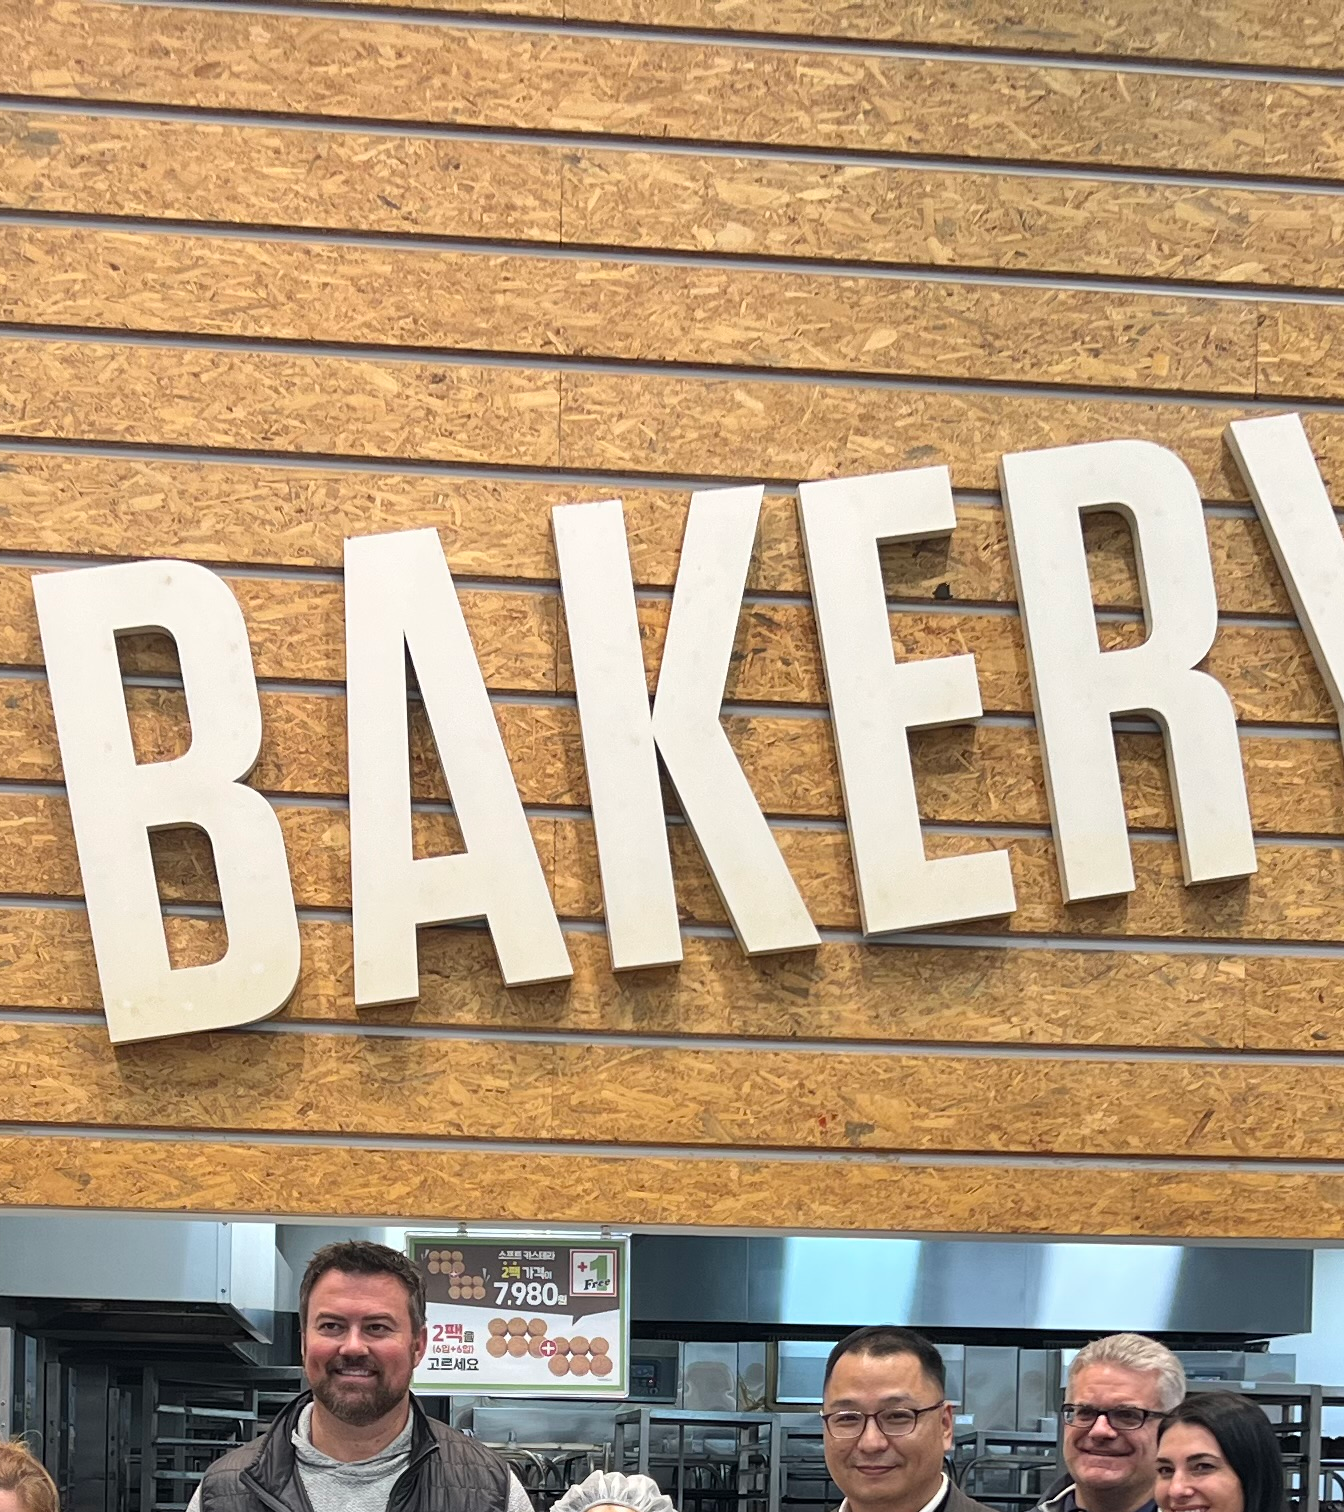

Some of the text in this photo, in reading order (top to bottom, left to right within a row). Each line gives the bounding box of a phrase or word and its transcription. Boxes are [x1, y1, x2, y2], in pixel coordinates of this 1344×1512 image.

[498, 1250, 555, 1261] 소프트 카스테라
[501, 1266, 552, 1279] 2팩 가격이
[583, 1279, 611, 1291] Free
[427, 1358, 479, 1371] 고르세요
